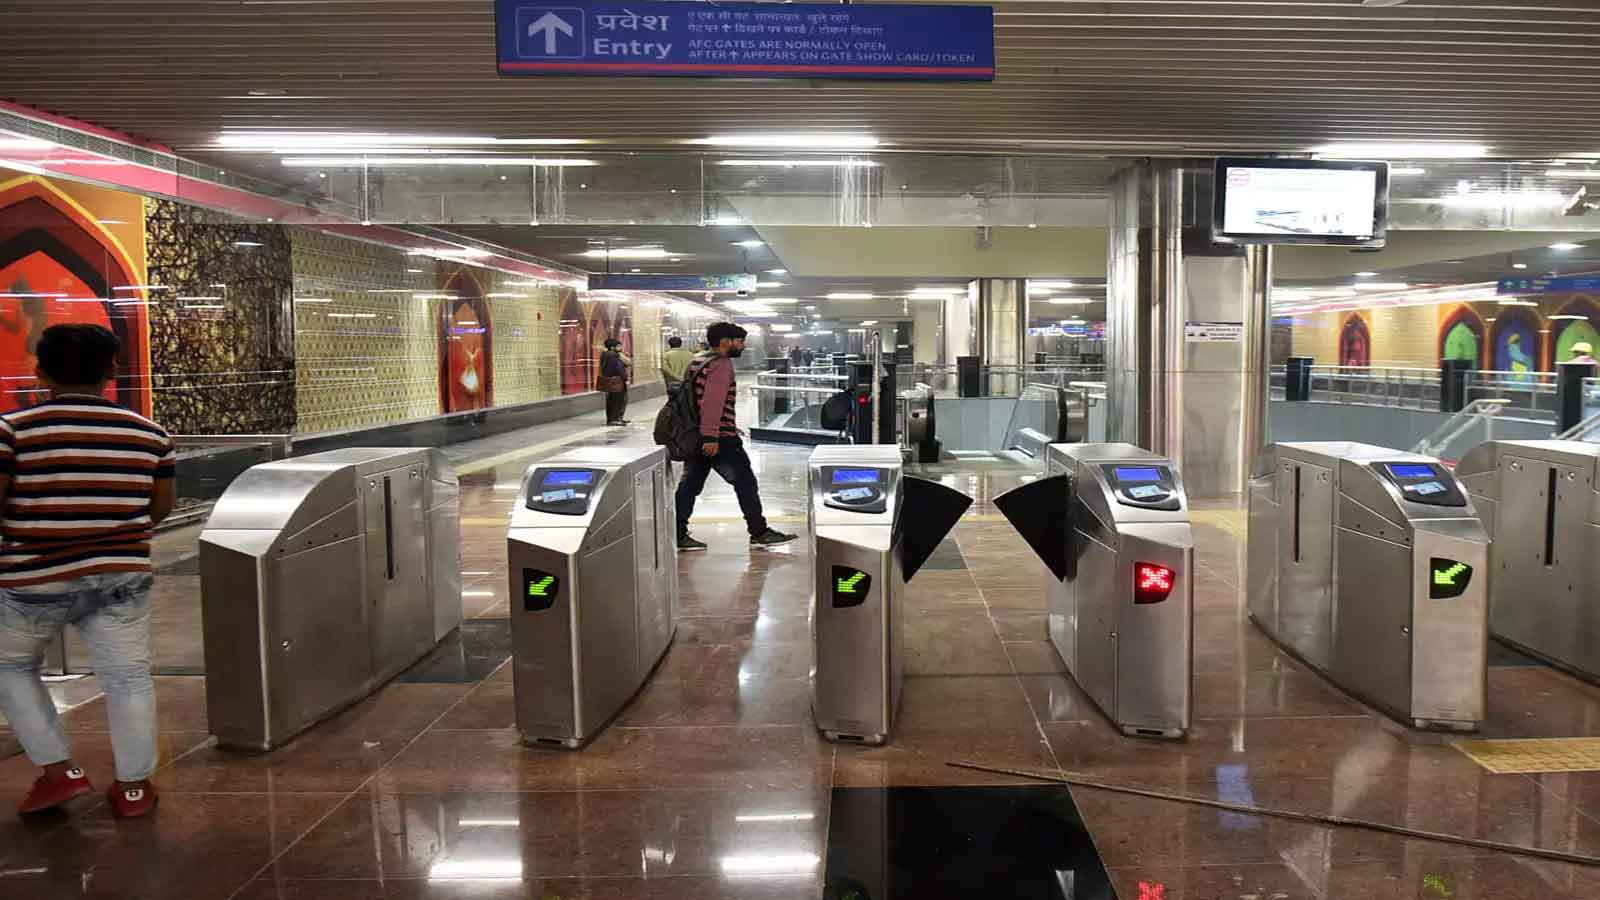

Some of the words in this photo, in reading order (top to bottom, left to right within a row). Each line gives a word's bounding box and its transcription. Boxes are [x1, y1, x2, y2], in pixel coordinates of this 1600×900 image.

[595, 8, 670, 32] प्रवेश
[594, 38, 672, 60] Entry
[688, 40, 712, 49] AFC
[715, 40, 755, 49] GATES
[759, 40, 780, 49] ARE
[784, 40, 850, 51] NORMALLY
[854, 41, 887, 51] OPEN
[688, 50, 726, 60] AFTER
[743, 51, 795, 60] APPEARS
[799, 51, 818, 61] ON
[822, 51, 852, 61] GATE
[857, 52, 893, 62] SHOW
[896, 53, 976, 63] CARD/TOKEN
